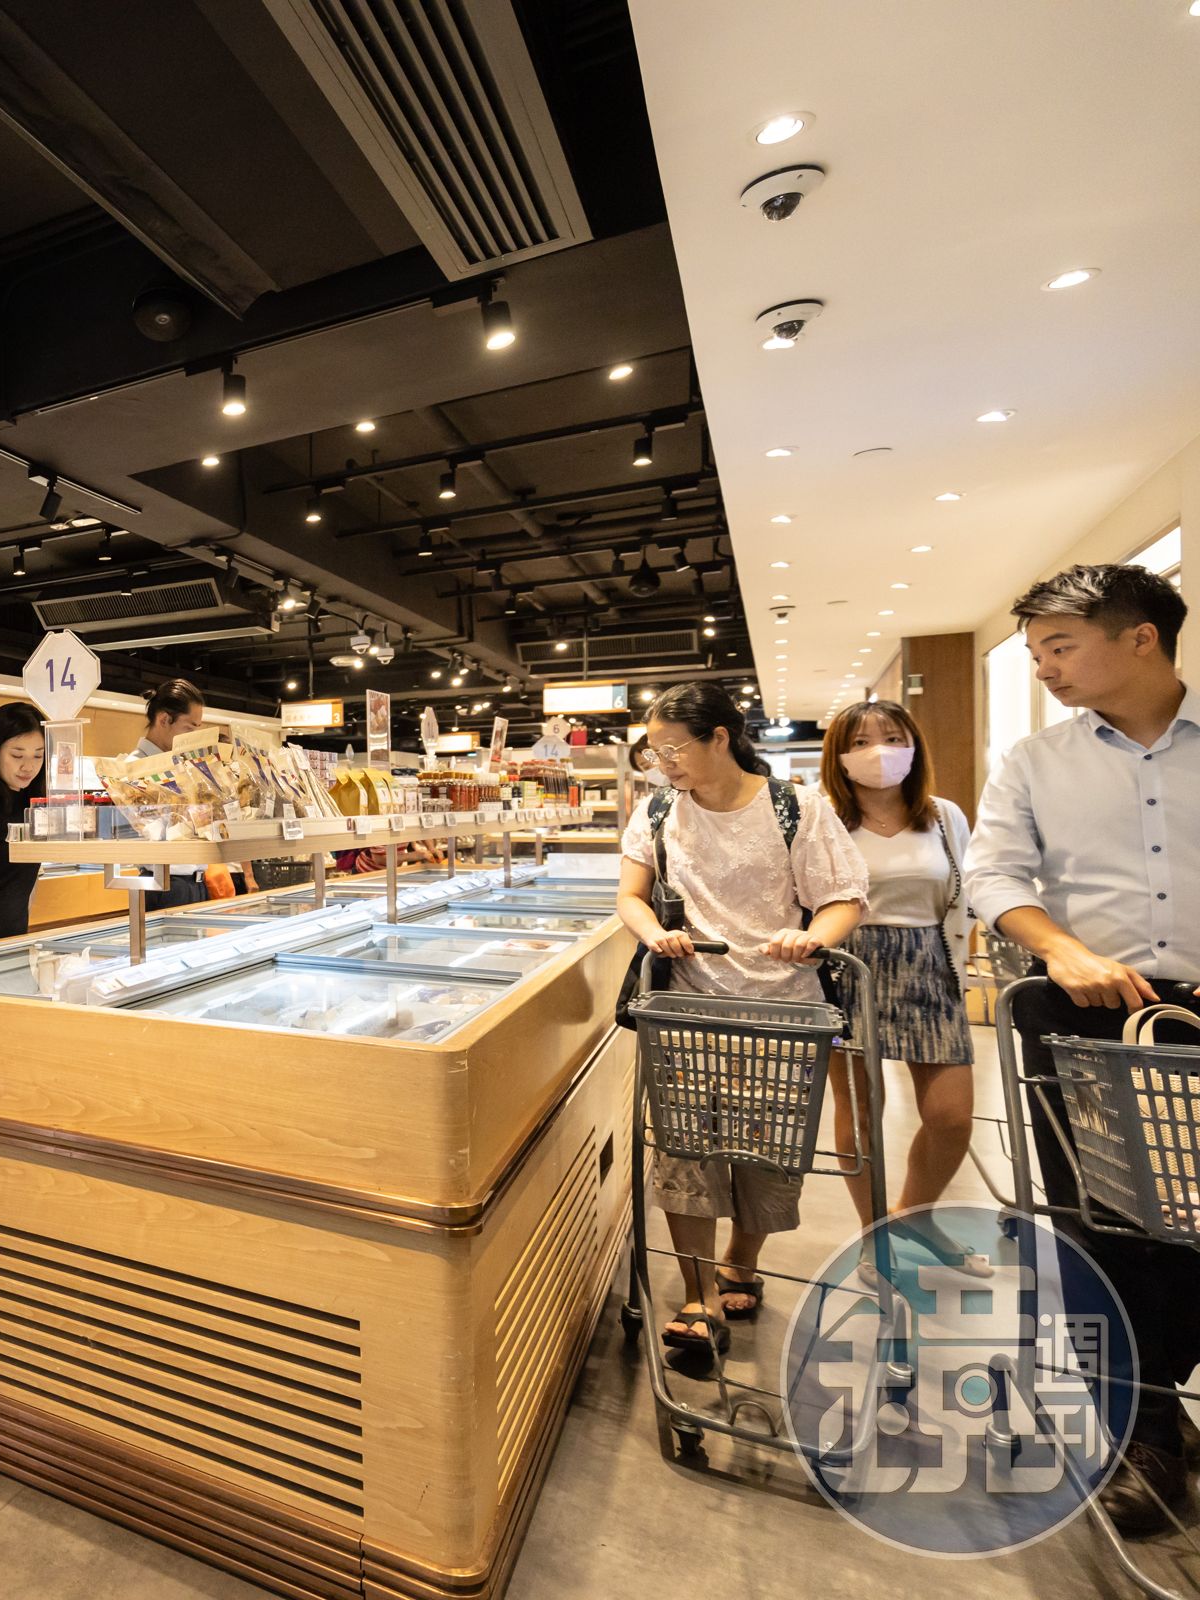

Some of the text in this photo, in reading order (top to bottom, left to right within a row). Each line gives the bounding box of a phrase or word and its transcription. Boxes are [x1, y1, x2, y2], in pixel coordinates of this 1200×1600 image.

[46, 657, 76, 692] 14
[614, 696, 623, 708] 6
[334, 713, 340, 723] 3
[544, 744, 558, 757] 14
